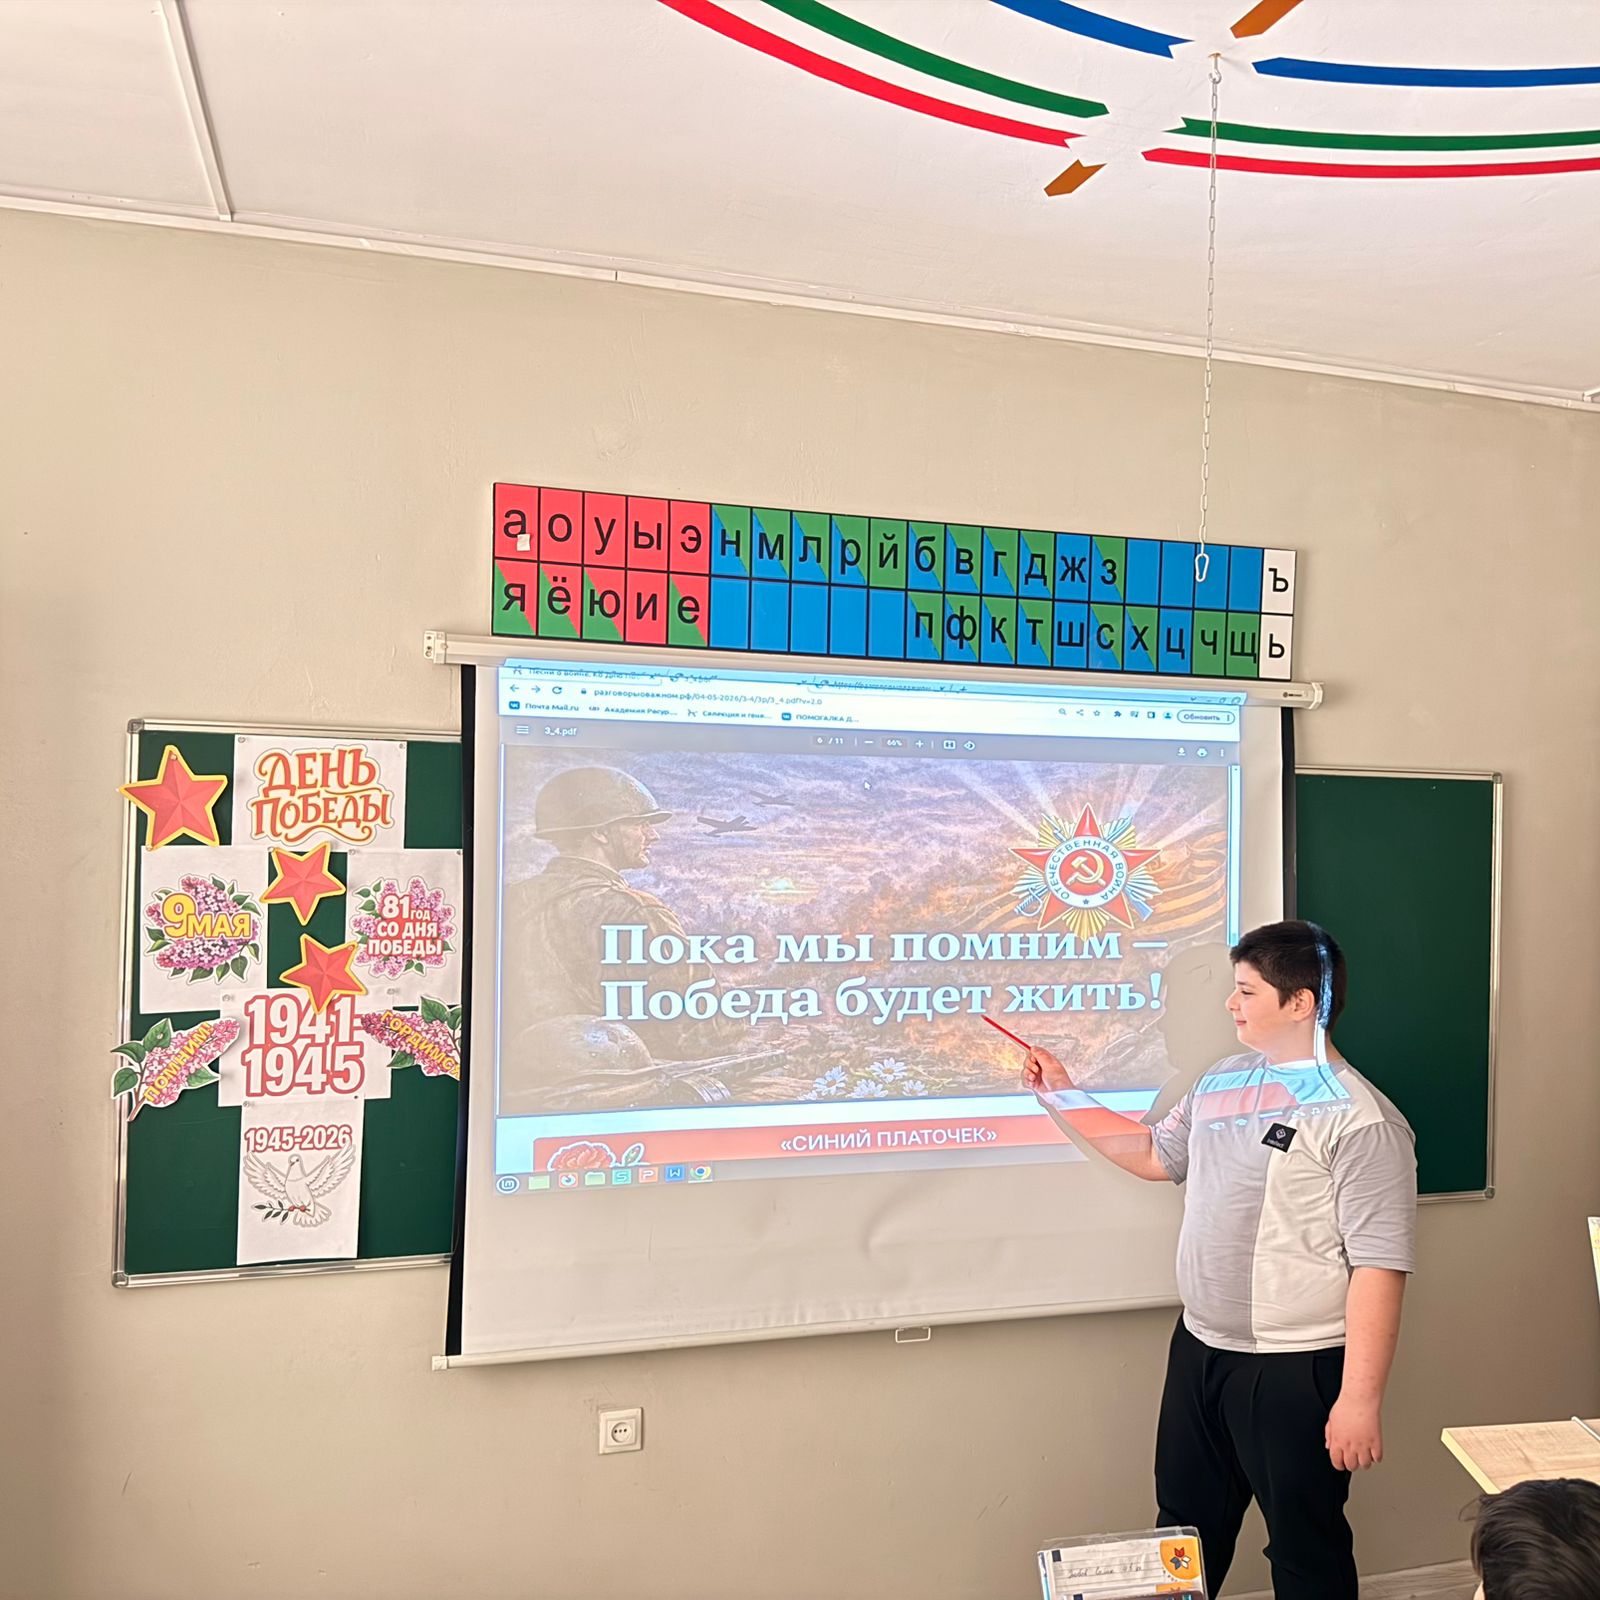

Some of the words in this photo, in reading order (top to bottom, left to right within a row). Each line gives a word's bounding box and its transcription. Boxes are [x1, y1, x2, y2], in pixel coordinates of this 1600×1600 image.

[503, 509, 527, 540] а
[548, 514, 572, 542] о
[594, 516, 617, 555] у
[634, 522, 662, 551] ы
[680, 525, 702, 553] э
[721, 529, 740, 557] н
[759, 532, 784, 561] м
[799, 535, 822, 563] л
[841, 538, 861, 575] р
[878, 533, 898, 570] й
[914, 536, 936, 572] б
[955, 548, 974, 574] в
[993, 551, 1007, 577] г
[1024, 553, 1047, 585] д
[1059, 556, 1087, 582] ж
[1101, 558, 1118, 584] з
[502, 583, 525, 612] я
[548, 576, 571, 615] ё
[589, 588, 621, 617] ю
[637, 592, 657, 620] и
[677, 594, 699, 624] е
[914, 612, 933, 638] п
[946, 605, 977, 649] ф
[991, 617, 1007, 643] к
[1026, 618, 1043, 645] т
[1057, 621, 1084, 647] ш
[1097, 623, 1115, 650] с
[1131, 625, 1148, 651] х
[1166, 627, 1185, 659] ц
[1200, 629, 1217, 655] ч
[1231, 631, 1257, 663] щ
[544, 726, 578, 736] 3_4.pdf
[1183, 713, 1221, 721] Обновить
[257, 748, 376, 797] ДЕНЬ
[252, 792, 391, 837] ПОБЕДЫ
[1048, 839, 1118, 900] ОТЕЧЕСТВЕННАЯ
[382, 894, 410, 919] 81
[410, 909, 431, 921] ГОД
[368, 940, 443, 957] ПОБЕДЫ
[377, 921, 399, 937] СО
[402, 922, 437, 939] ДНЯ
[600, 923, 757, 965] Пока
[776, 932, 873, 964] мы
[890, 930, 1122, 963] помним
[600, 977, 822, 1026] Победа
[836, 976, 993, 1024] будет
[1004, 973, 1163, 1013] жить!
[143, 1021, 214, 1103] ПОМНИМ!
[242, 1043, 365, 1097] 1945
[244, 1124, 352, 1153] 1945-2026
[781, 1128, 871, 1151] «СИНИЙ
[877, 1126, 998, 1147] ПЛАТОЧЕК»
